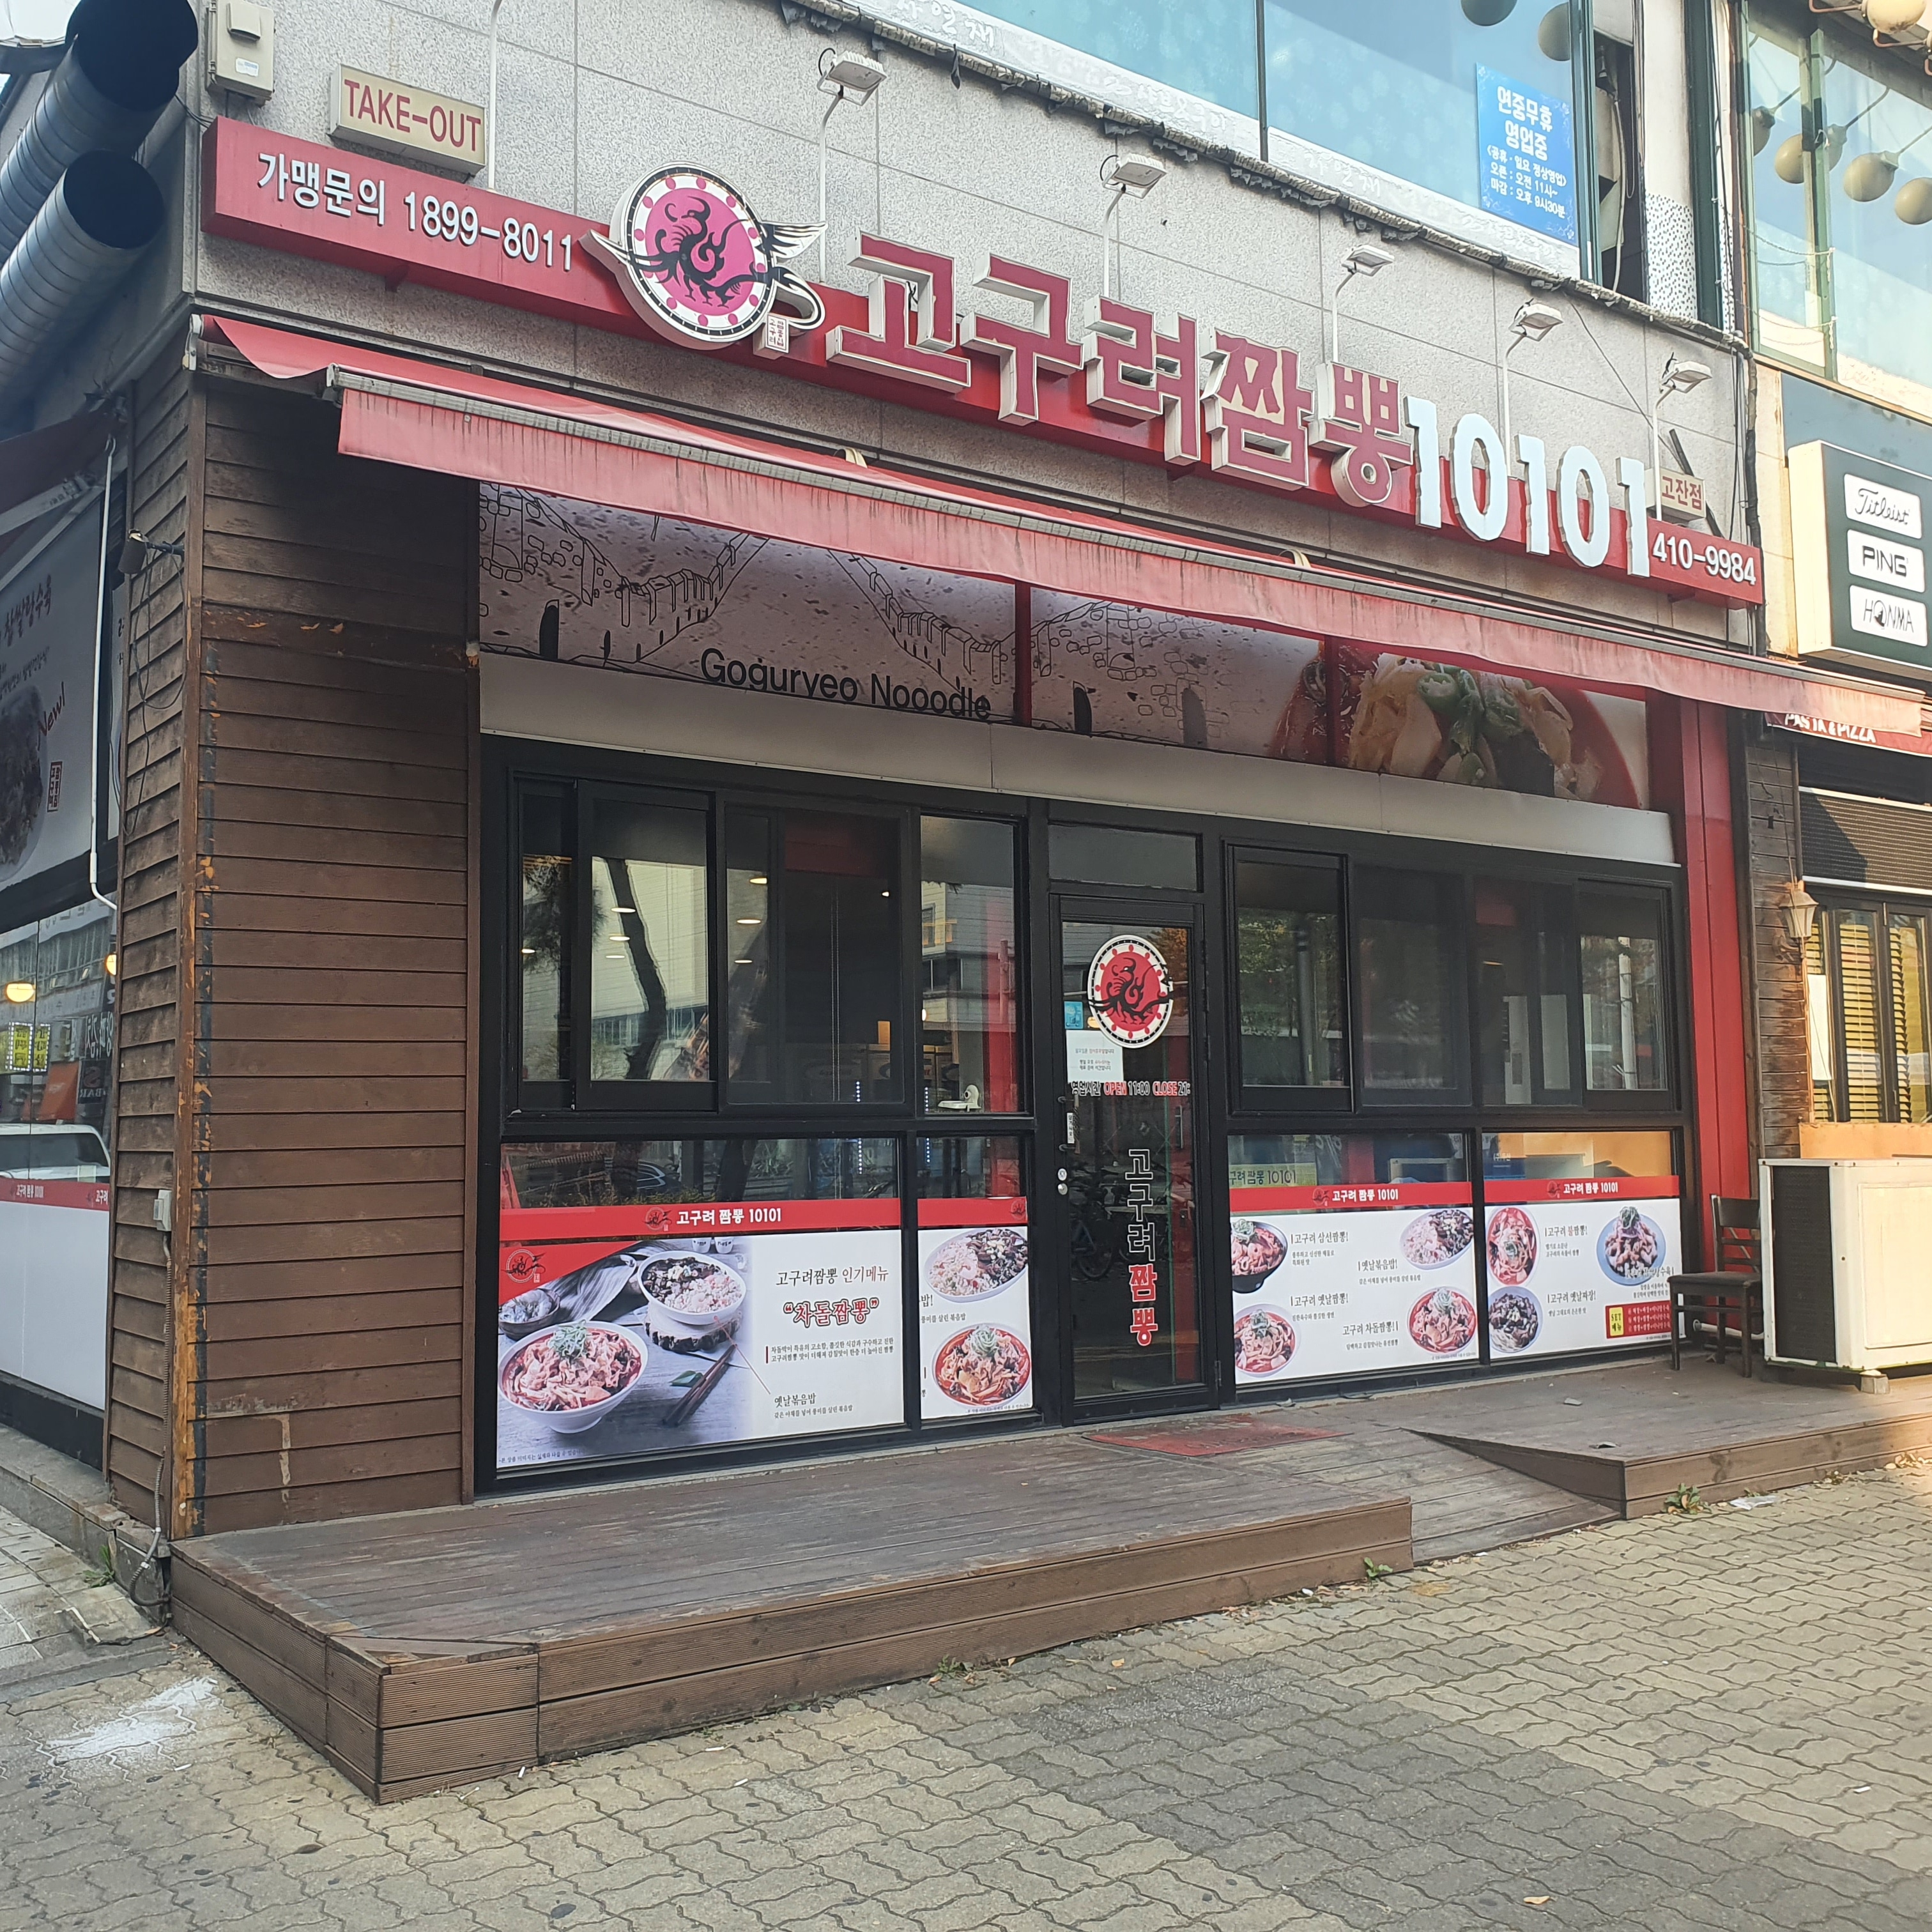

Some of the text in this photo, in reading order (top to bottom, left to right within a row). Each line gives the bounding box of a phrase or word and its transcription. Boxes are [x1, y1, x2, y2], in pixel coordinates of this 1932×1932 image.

[344, 79, 482, 152] TAKE-OUT
[1497, 86, 1552, 132] 연중무휴
[1505, 120, 1548, 161] 영업중
[1514, 155, 1531, 173] 일요
[1490, 162, 1507, 180] 오픈
[1515, 172, 1532, 189] 오전
[1491, 178, 1508, 195] 마감
[1515, 188, 1533, 205] 오후
[1535, 195, 1566, 219] 9시30분
[257, 152, 573, 272] 가맹문의 1899-8011
[827, 229, 1651, 579] 고구려짬뽕 10101
[1661, 473, 1703, 511] 고잔점
[1855, 487, 1910, 525] Titleist
[1652, 532, 1757, 586] 410-9984
[1862, 545, 1907, 578] PING
[871, 673, 992, 721] Nooodle
[1071, 1081, 1101, 1096] 영업시간
[1103, 1080, 1128, 1096] OPEN
[1128, 1080, 1150, 1096] 11:00
[1153, 1080, 1178, 1096] CLOSE
[1229, 1170, 1297, 1186] 구려 짬뽕 10101
[1332, 1188, 1399, 1202] 고구려 짬뽕 10101
[1563, 1181, 1618, 1195] 고구려 짬뽕 10101
[676, 1208, 781, 1226] 고구려 짬뽕 10101
[1294, 1231, 1349, 1244] 고구려 삼선짬뽕!
[1548, 1225, 1566, 1237] 고구려
[1362, 1259, 1398, 1271] 옛날볶음밥!
[775, 1266, 889, 1287] 고구려짬뽕 인기메뉴
[1294, 1292, 1349, 1307] 고구려 옛날짬뽕!
[1551, 1292, 1568, 1303] 고구려
[939, 1314, 949, 1322] 살린
[950, 1312, 966, 1322] 볶음밥
[1611, 1313, 1621, 1321] SET
[1342, 1323, 1363, 1336] 고구려
[1611, 1322, 1621, 1332] 메뉴
[771, 1345, 792, 1354] 차돌박이
[846, 1339, 861, 1348] 식감과
[862, 1338, 882, 1346] 구수하고
[799, 1352, 809, 1360] 맛이
[827, 1349, 848, 1358] 감칠맛이
[861, 1347, 866, 1355] 더
[774, 1393, 816, 1408] 옛날볶음밥
